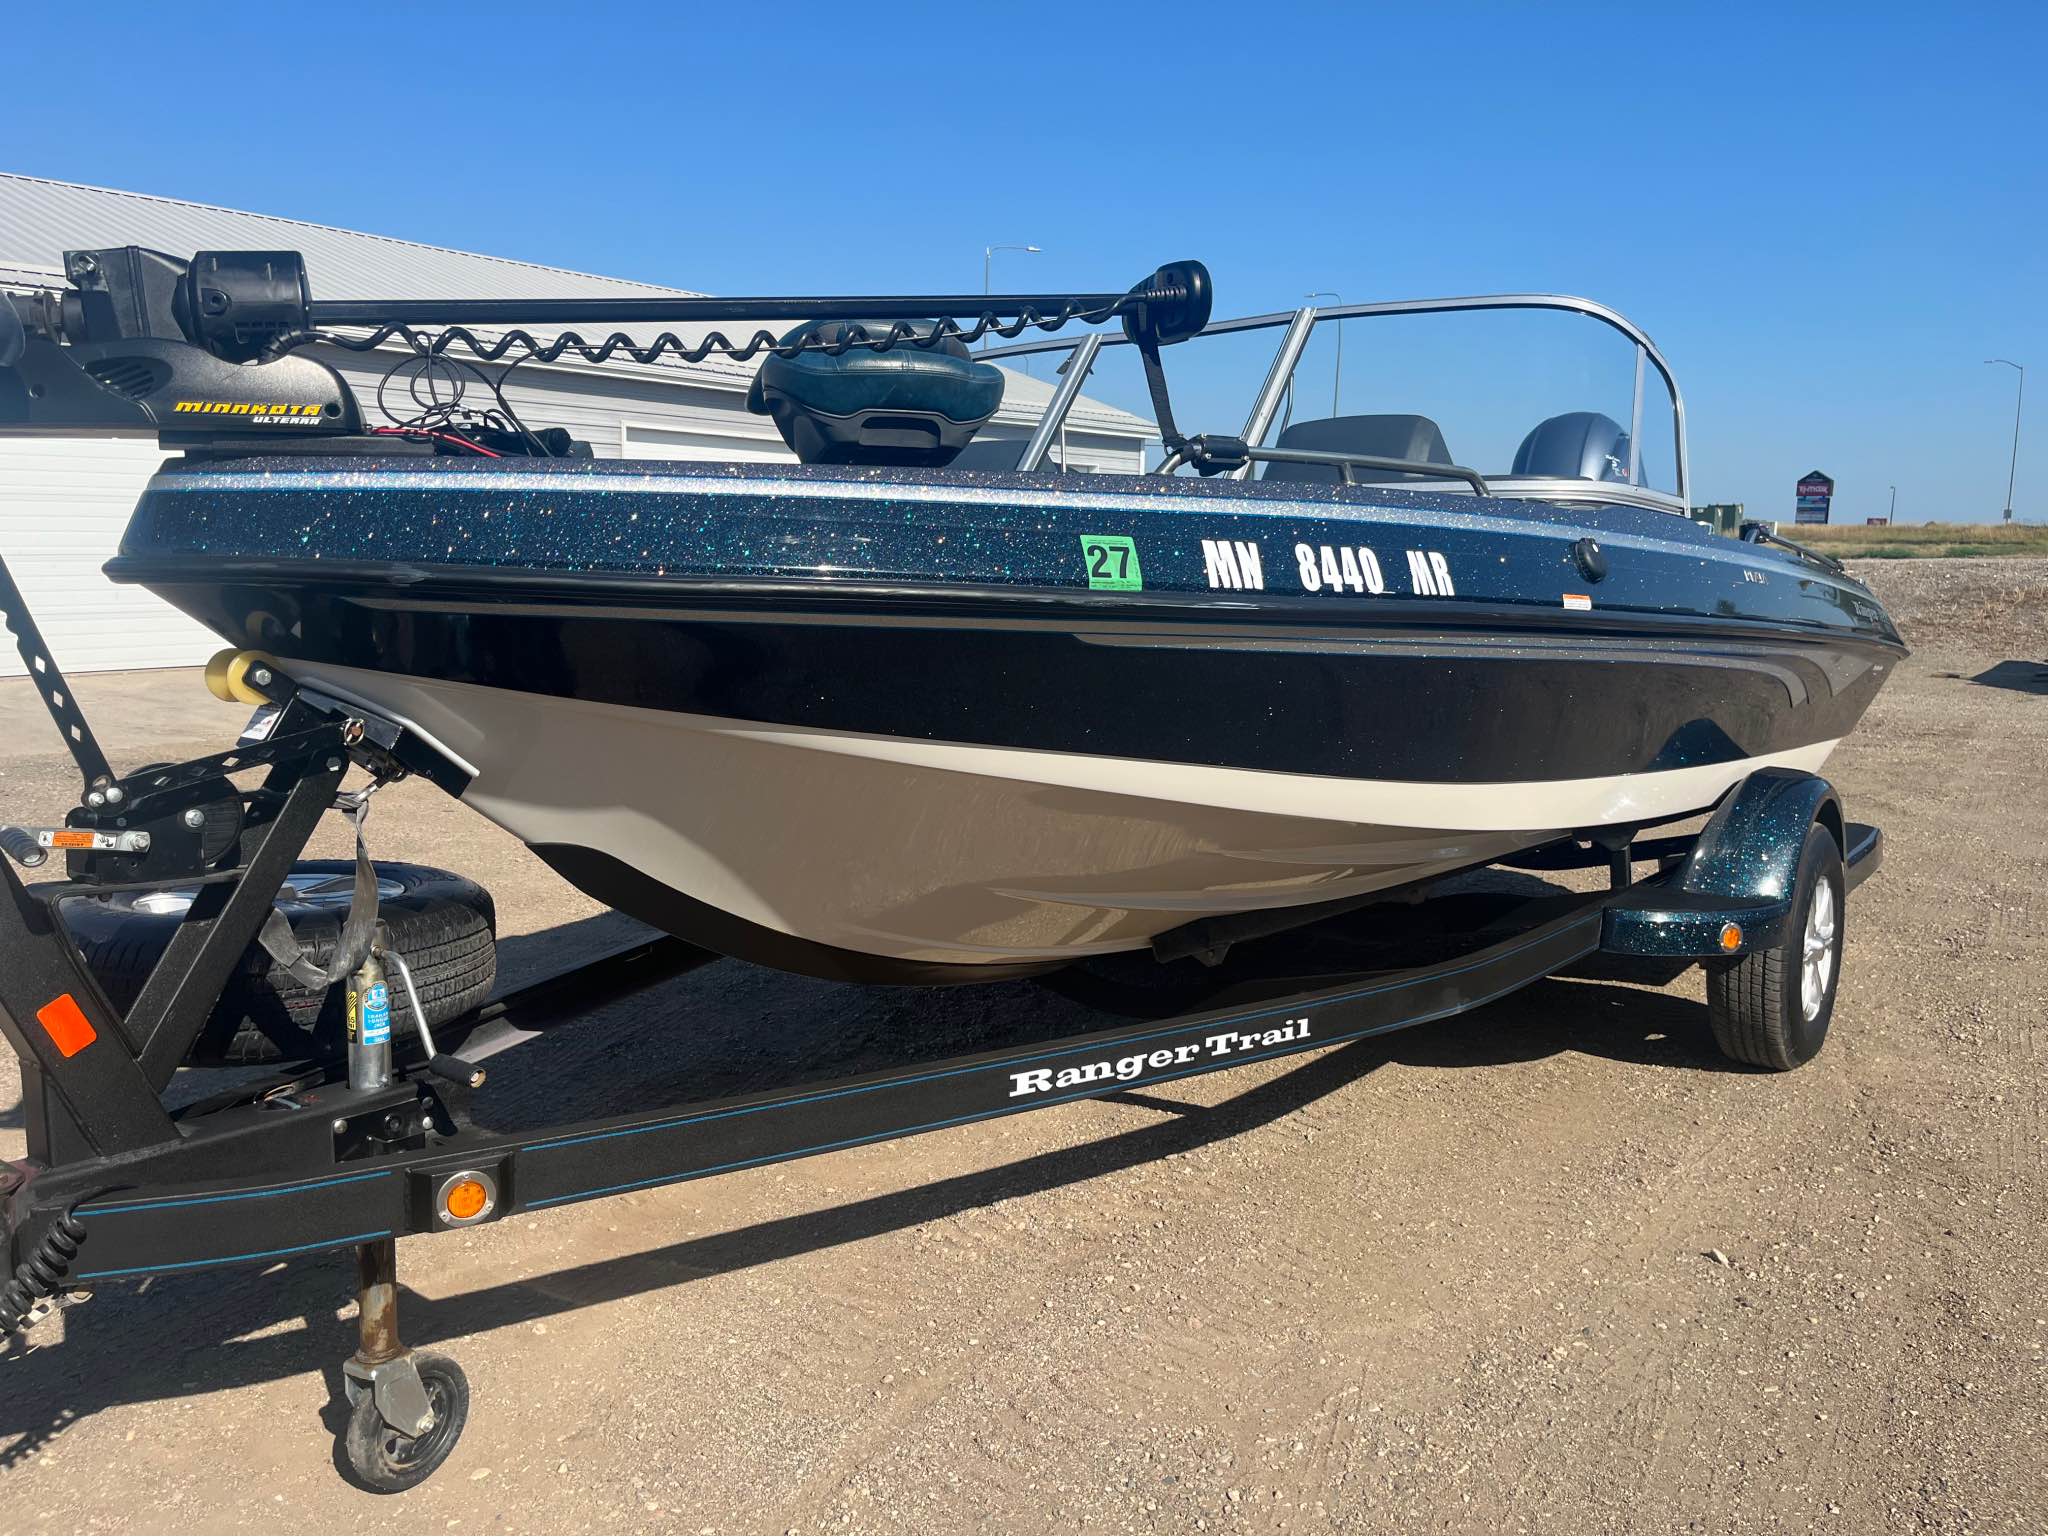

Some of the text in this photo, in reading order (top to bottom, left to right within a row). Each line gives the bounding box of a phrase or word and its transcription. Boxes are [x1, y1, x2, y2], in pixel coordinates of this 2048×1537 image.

[1087, 544, 1130, 579] 27
[1201, 539, 1455, 596] MN 8440 MR
[1009, 1018, 1311, 1098] Ranger Trail
